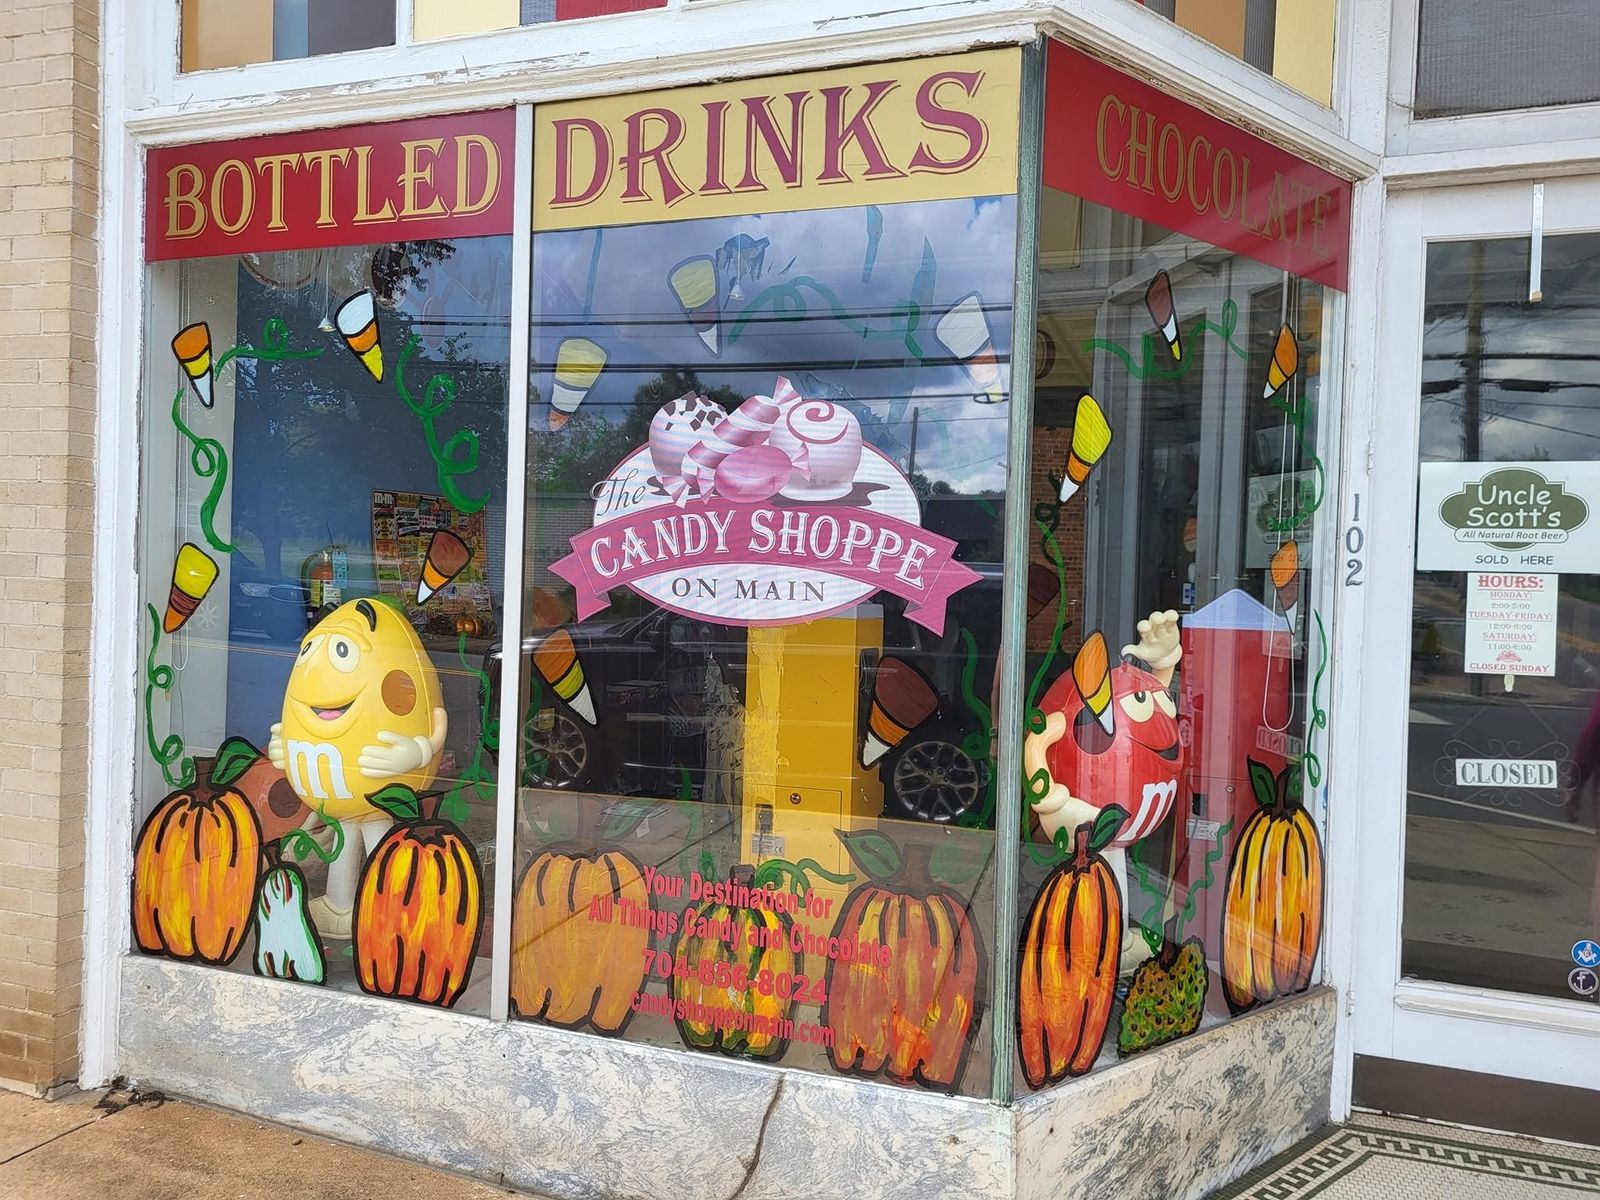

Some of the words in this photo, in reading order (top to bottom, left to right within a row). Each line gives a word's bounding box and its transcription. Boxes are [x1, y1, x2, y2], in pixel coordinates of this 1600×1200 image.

[549, 70, 990, 208] DRINKS
[164, 134, 503, 241] BOTTLED
[1096, 95, 1332, 258] CHOCOLATE
[590, 468, 645, 516] The
[1466, 507, 1561, 527] Scott's
[1477, 484, 1551, 505] Uncle
[589, 509, 737, 578] CANDY
[748, 509, 937, 589] SHOPPE
[1345, 493, 1364, 586] 102
[1475, 555, 1509, 565] SOLD
[1520, 555, 1553, 565] HERE
[1478, 531, 1513, 539] Natural
[1516, 531, 1538, 539] Root
[1541, 532, 1563, 540] Beer
[671, 577, 718, 598] ON
[734, 578, 826, 601] MAIN
[1478, 575, 1543, 588] HOURS:
[1490, 591, 1532, 599] MONDAY:
[1482, 632, 1536, 640] SATURDAY:
[1470, 663, 1506, 671] CLOSED
[1509, 664, 1549, 672] SUNDAY
[287, 739, 353, 800] m
[1461, 762, 1555, 786] CLOSED
[1115, 778, 1177, 842] m
[643, 865, 684, 896] Your
[690, 872, 798, 912] Destination
[805, 888, 833, 919] for
[588, 895, 613, 923] All
[618, 897, 678, 939] Things
[685, 909, 743, 950] Candy
[748, 921, 783, 950] and
[789, 924, 892, 968] Chocolate
[641, 949, 827, 1004] 704-856-8024
[630, 991, 836, 1047] candyshoppeonmain.com
